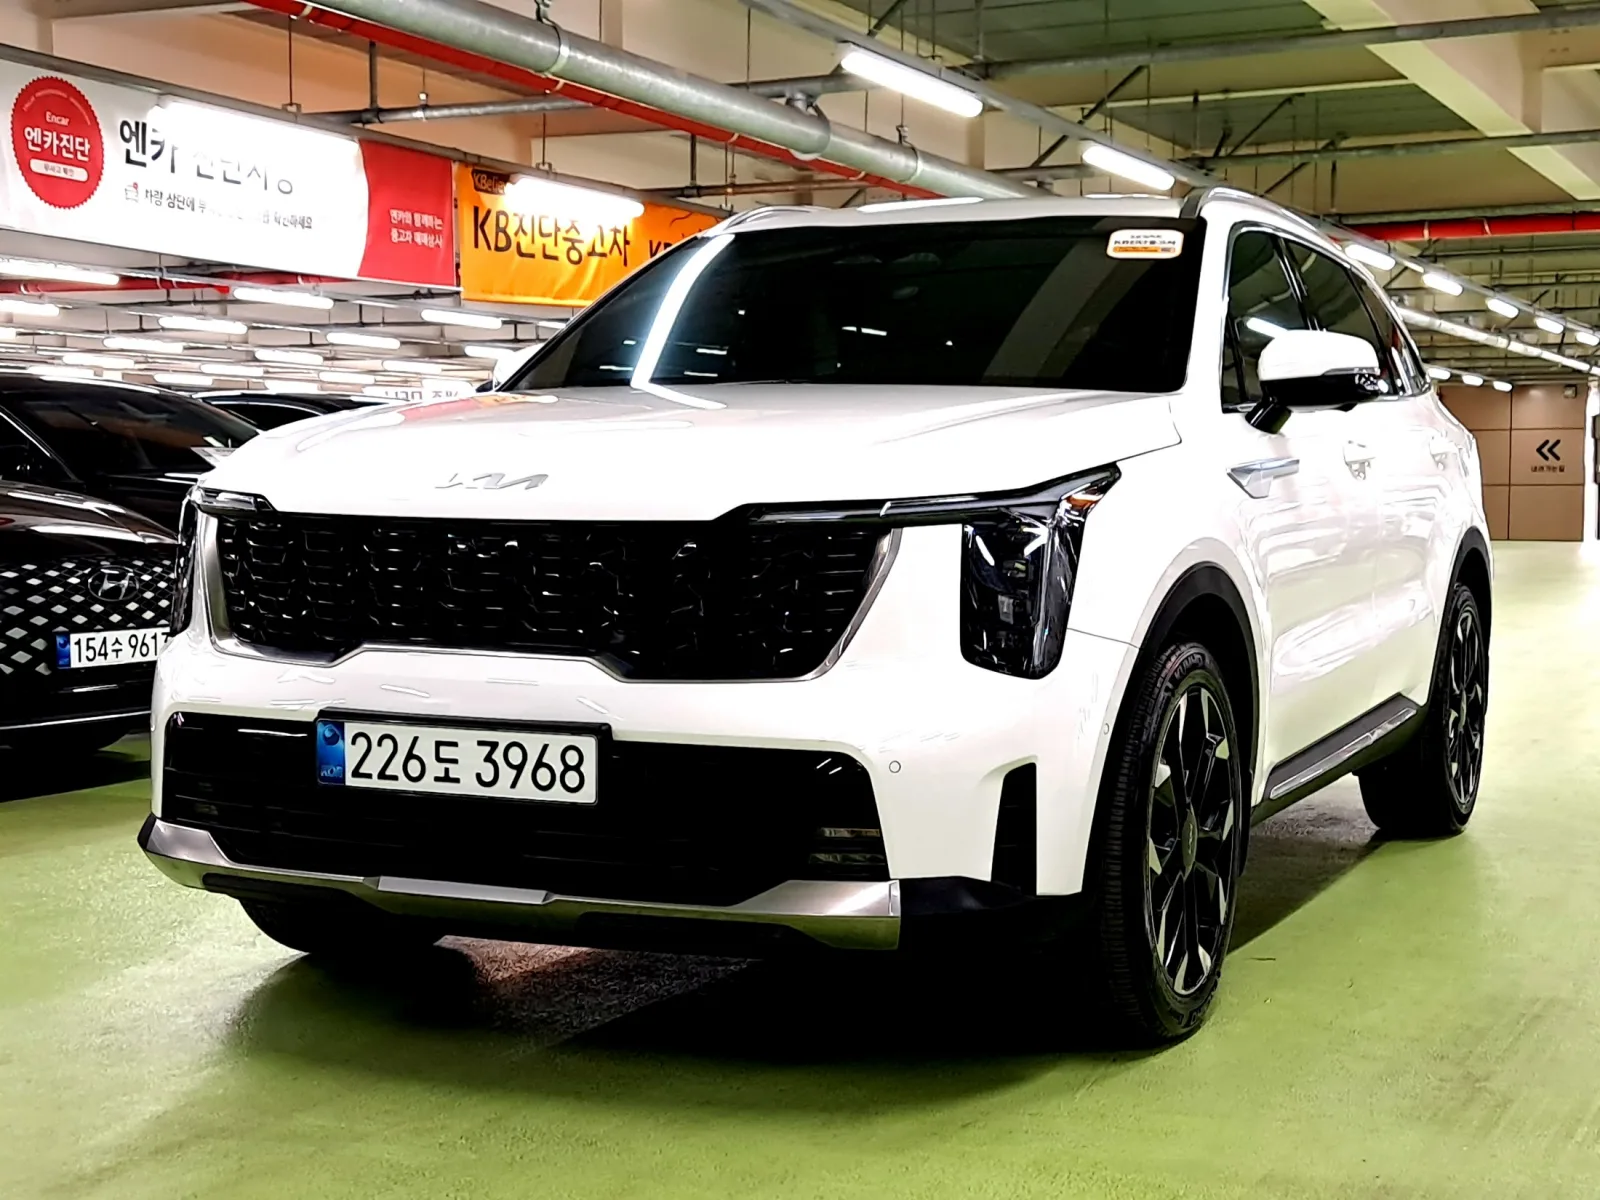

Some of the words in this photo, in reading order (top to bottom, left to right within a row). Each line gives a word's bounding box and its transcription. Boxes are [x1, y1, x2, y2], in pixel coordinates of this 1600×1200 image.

[46, 111, 70, 127] Encar
[24, 126, 91, 162] 엔카진단
[472, 206, 631, 268] KB진단중고차
[74, 636, 123, 663] 154수
[350, 731, 461, 784] 226도
[475, 740, 586, 794] 3968
